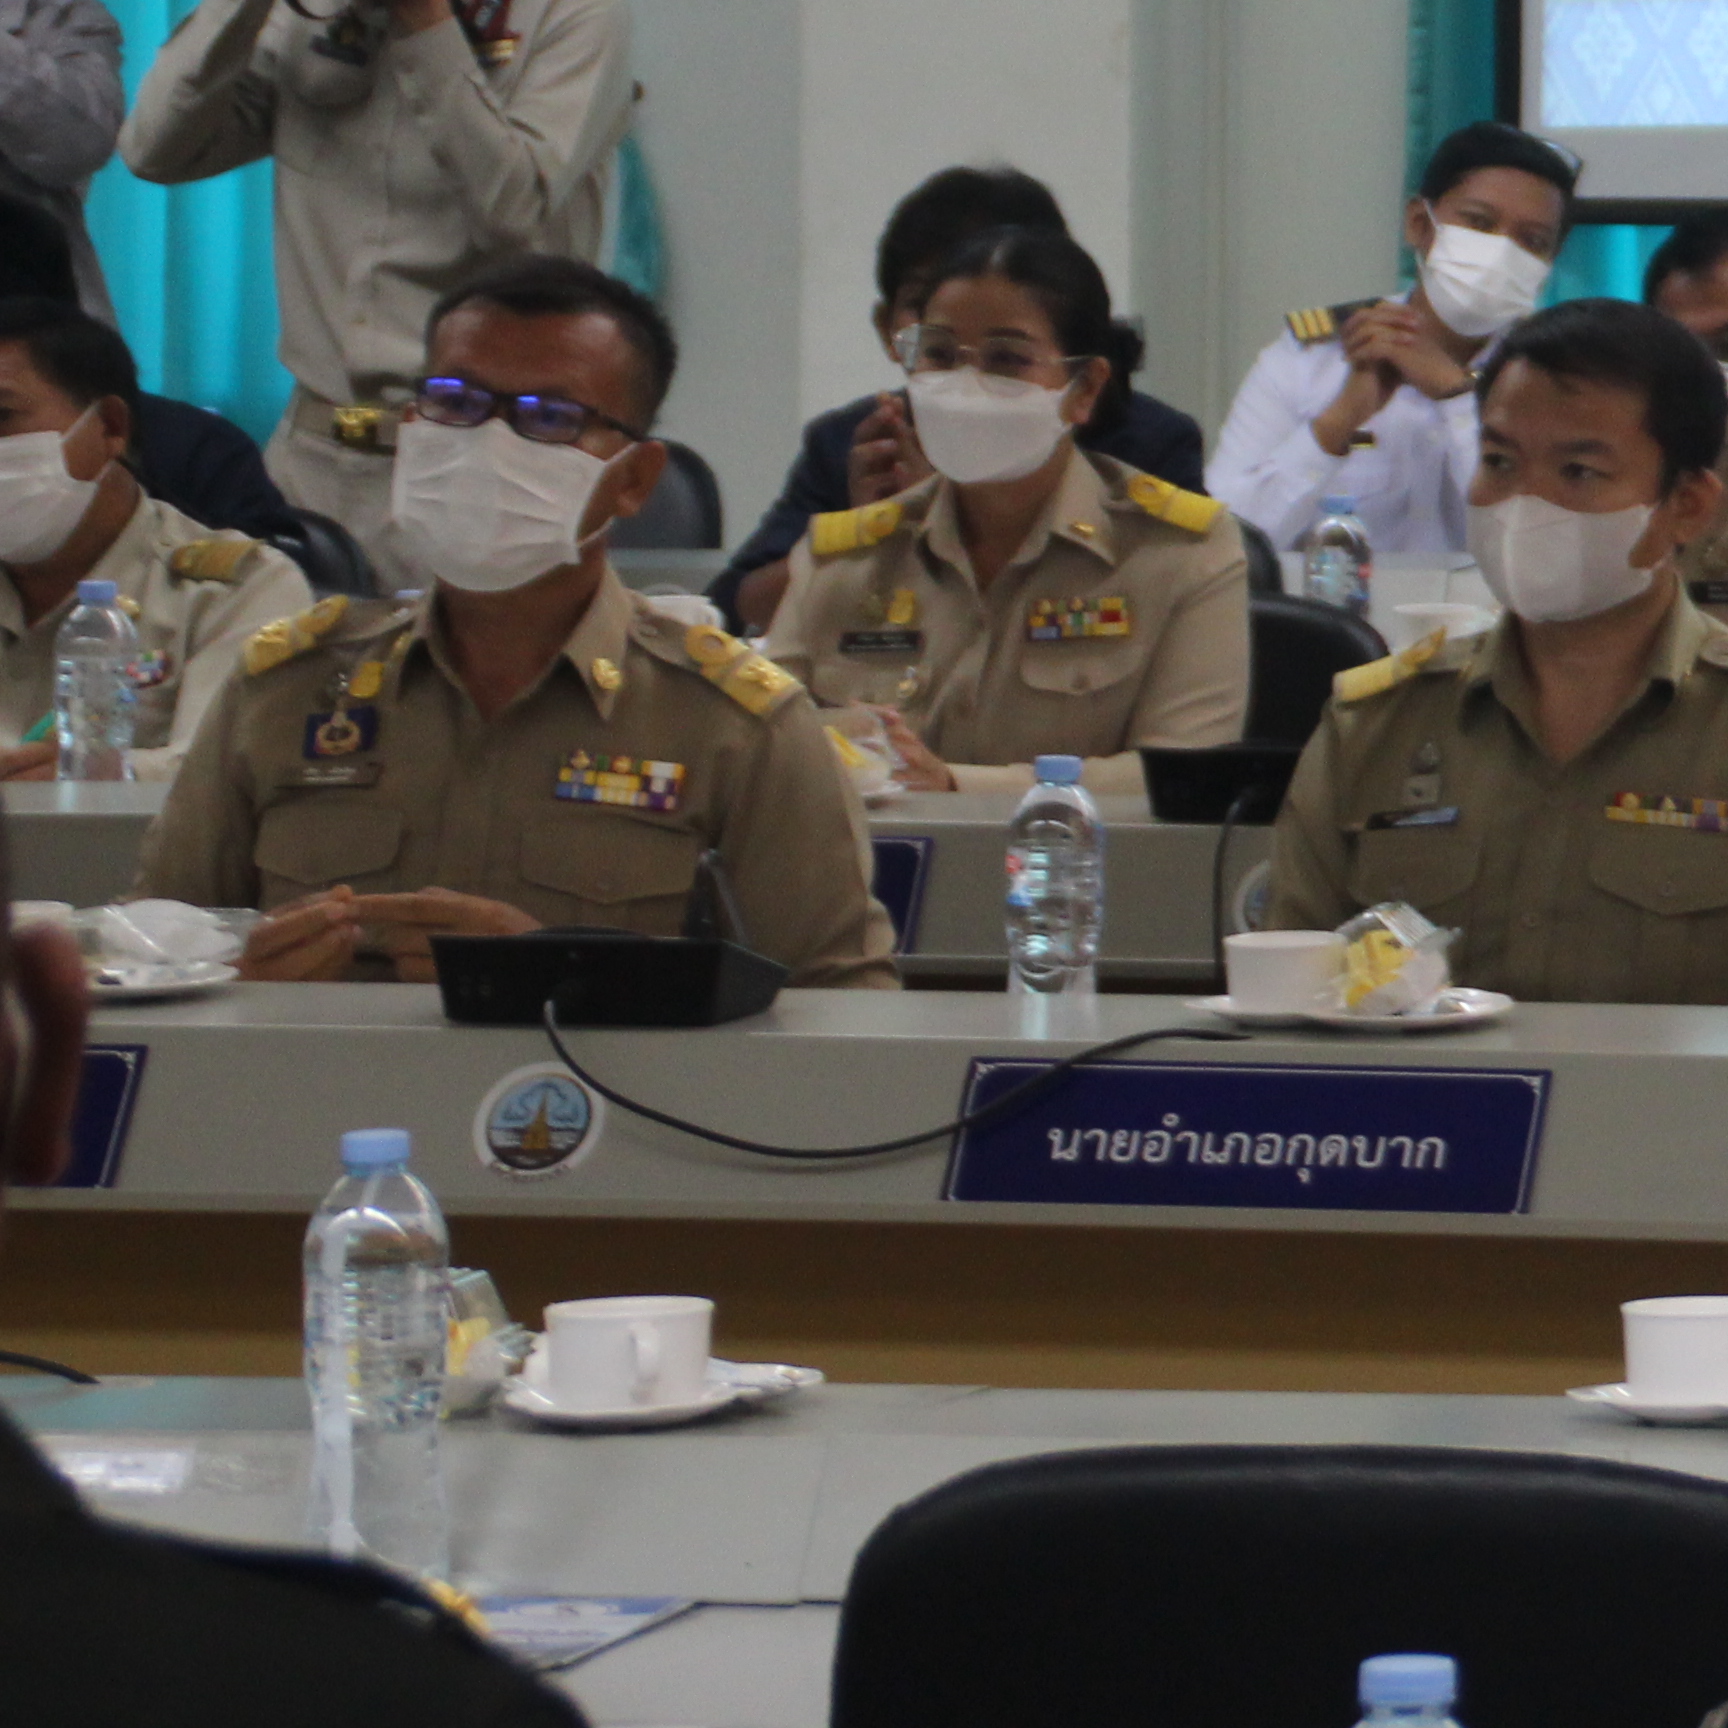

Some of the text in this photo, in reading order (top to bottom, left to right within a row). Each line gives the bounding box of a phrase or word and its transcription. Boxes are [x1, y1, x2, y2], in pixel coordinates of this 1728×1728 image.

[1047, 1113, 1447, 1184] นายอำเภอกุดบาก
